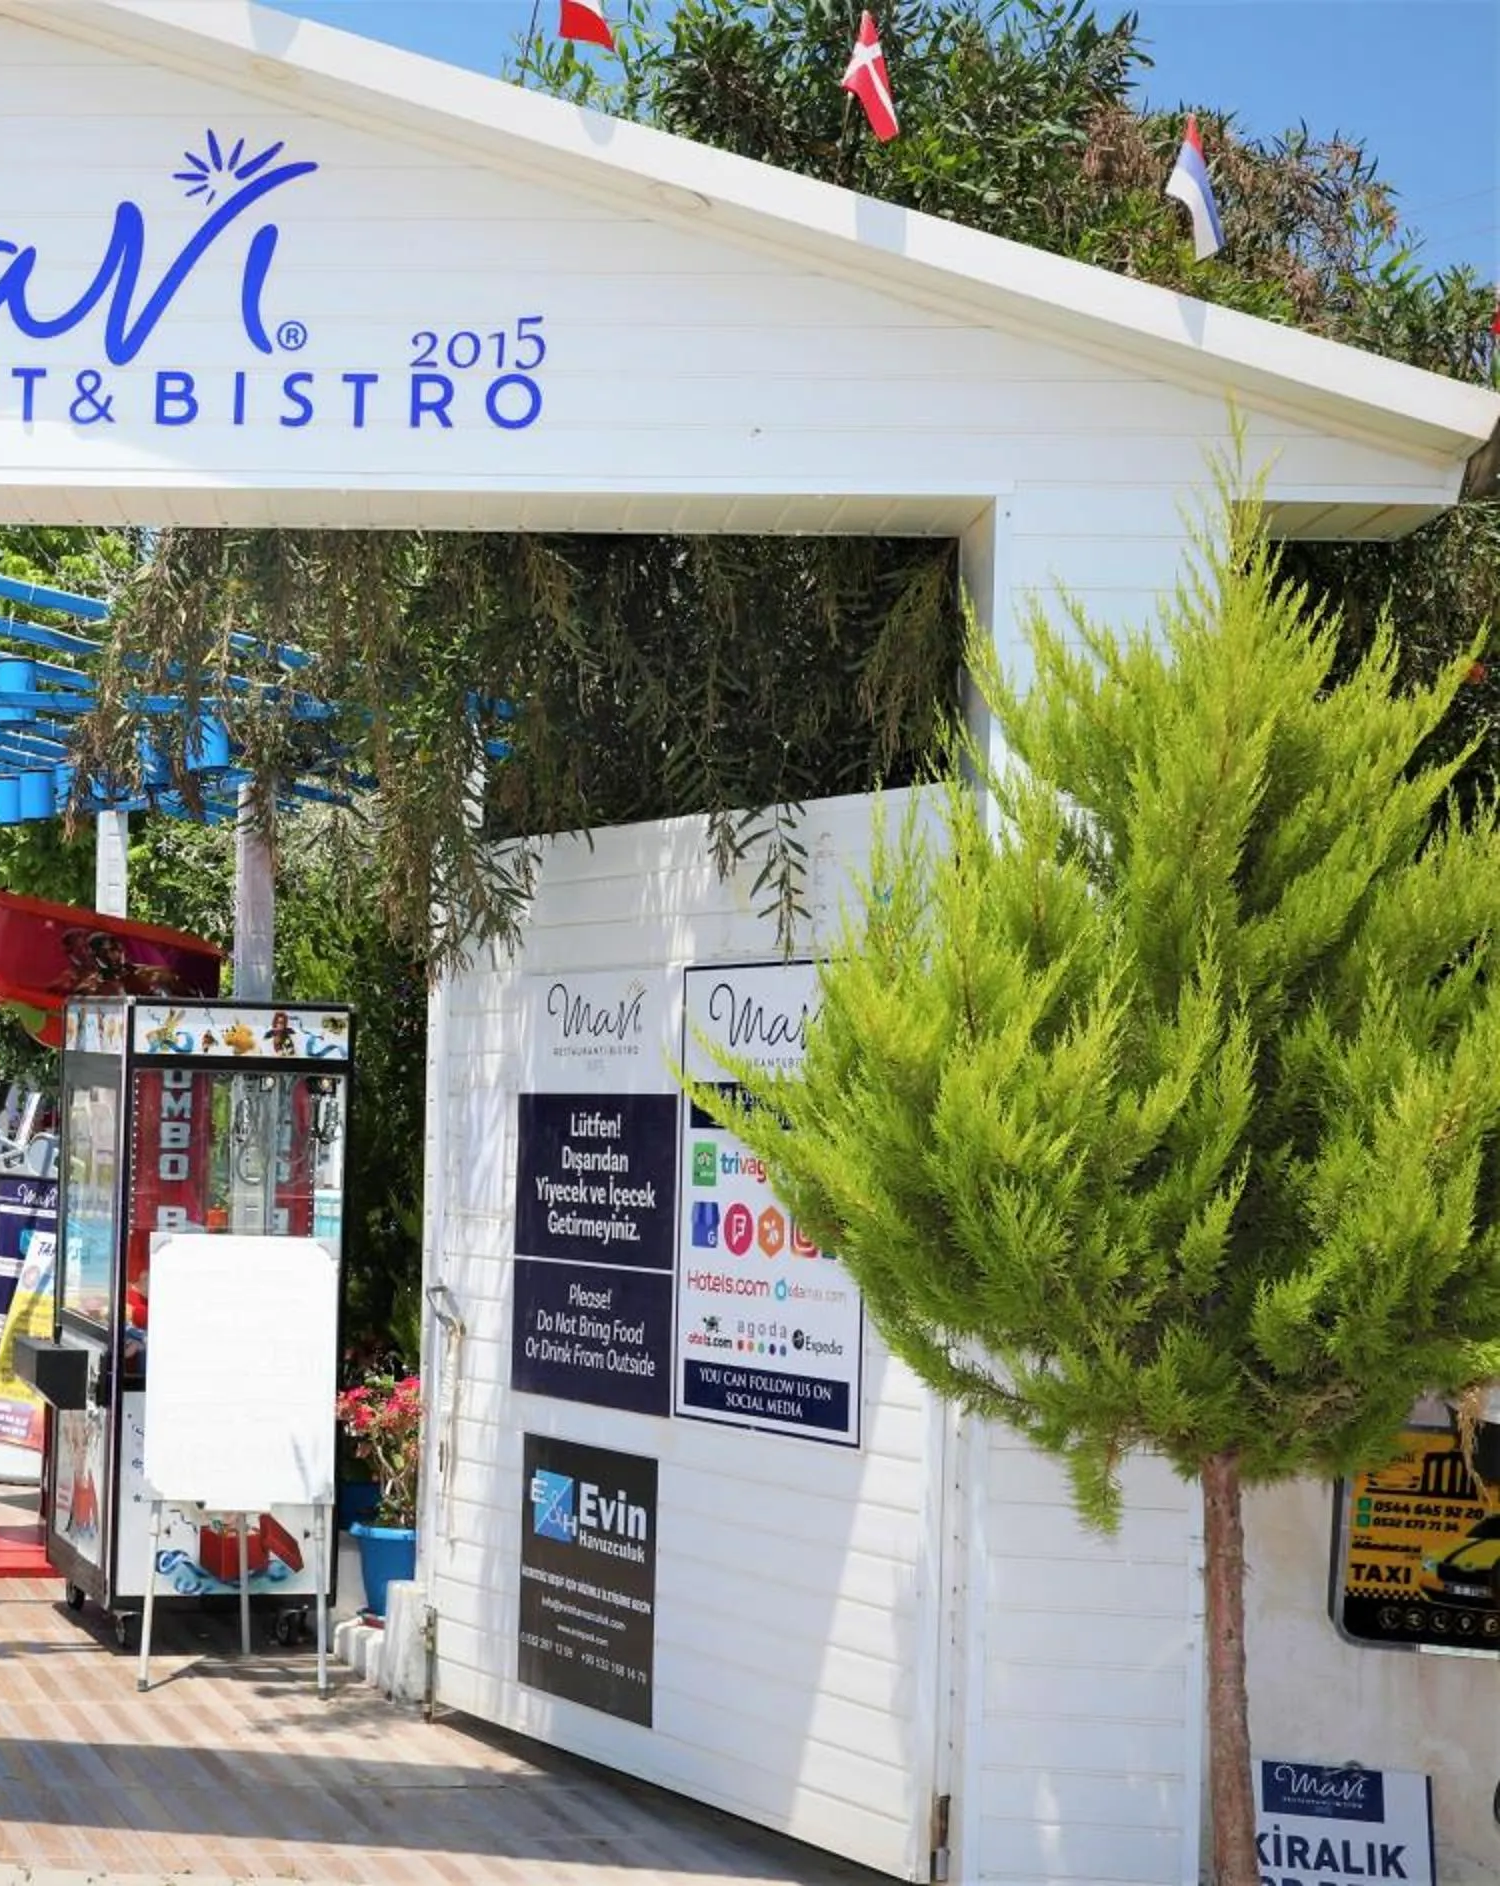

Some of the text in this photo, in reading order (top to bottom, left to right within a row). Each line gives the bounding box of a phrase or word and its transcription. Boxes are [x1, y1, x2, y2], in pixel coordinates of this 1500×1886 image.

[410, 315, 547, 371] 2015
[570, 1111, 621, 1139] Lütfen!
[720, 1151, 768, 1184] trivag
[535, 1174, 657, 1213] Yiyecek ve İçecek
[547, 1209, 641, 1246] Getirmeyiniz.
[568, 1282, 613, 1311] Please!
[687, 1269, 771, 1298] Hotels.com
[536, 1308, 645, 1347] Do Not Bring Food
[525, 1335, 656, 1378] Or Drink From Outside
[699, 1366, 832, 1402] YOU CAN FOLLOW US ON
[725, 1390, 804, 1419] SOCIAL MEDIA
[578, 1481, 648, 1541] Evin
[578, 1529, 646, 1565] Havuzculuk
[1351, 1563, 1412, 1586] TAXI
